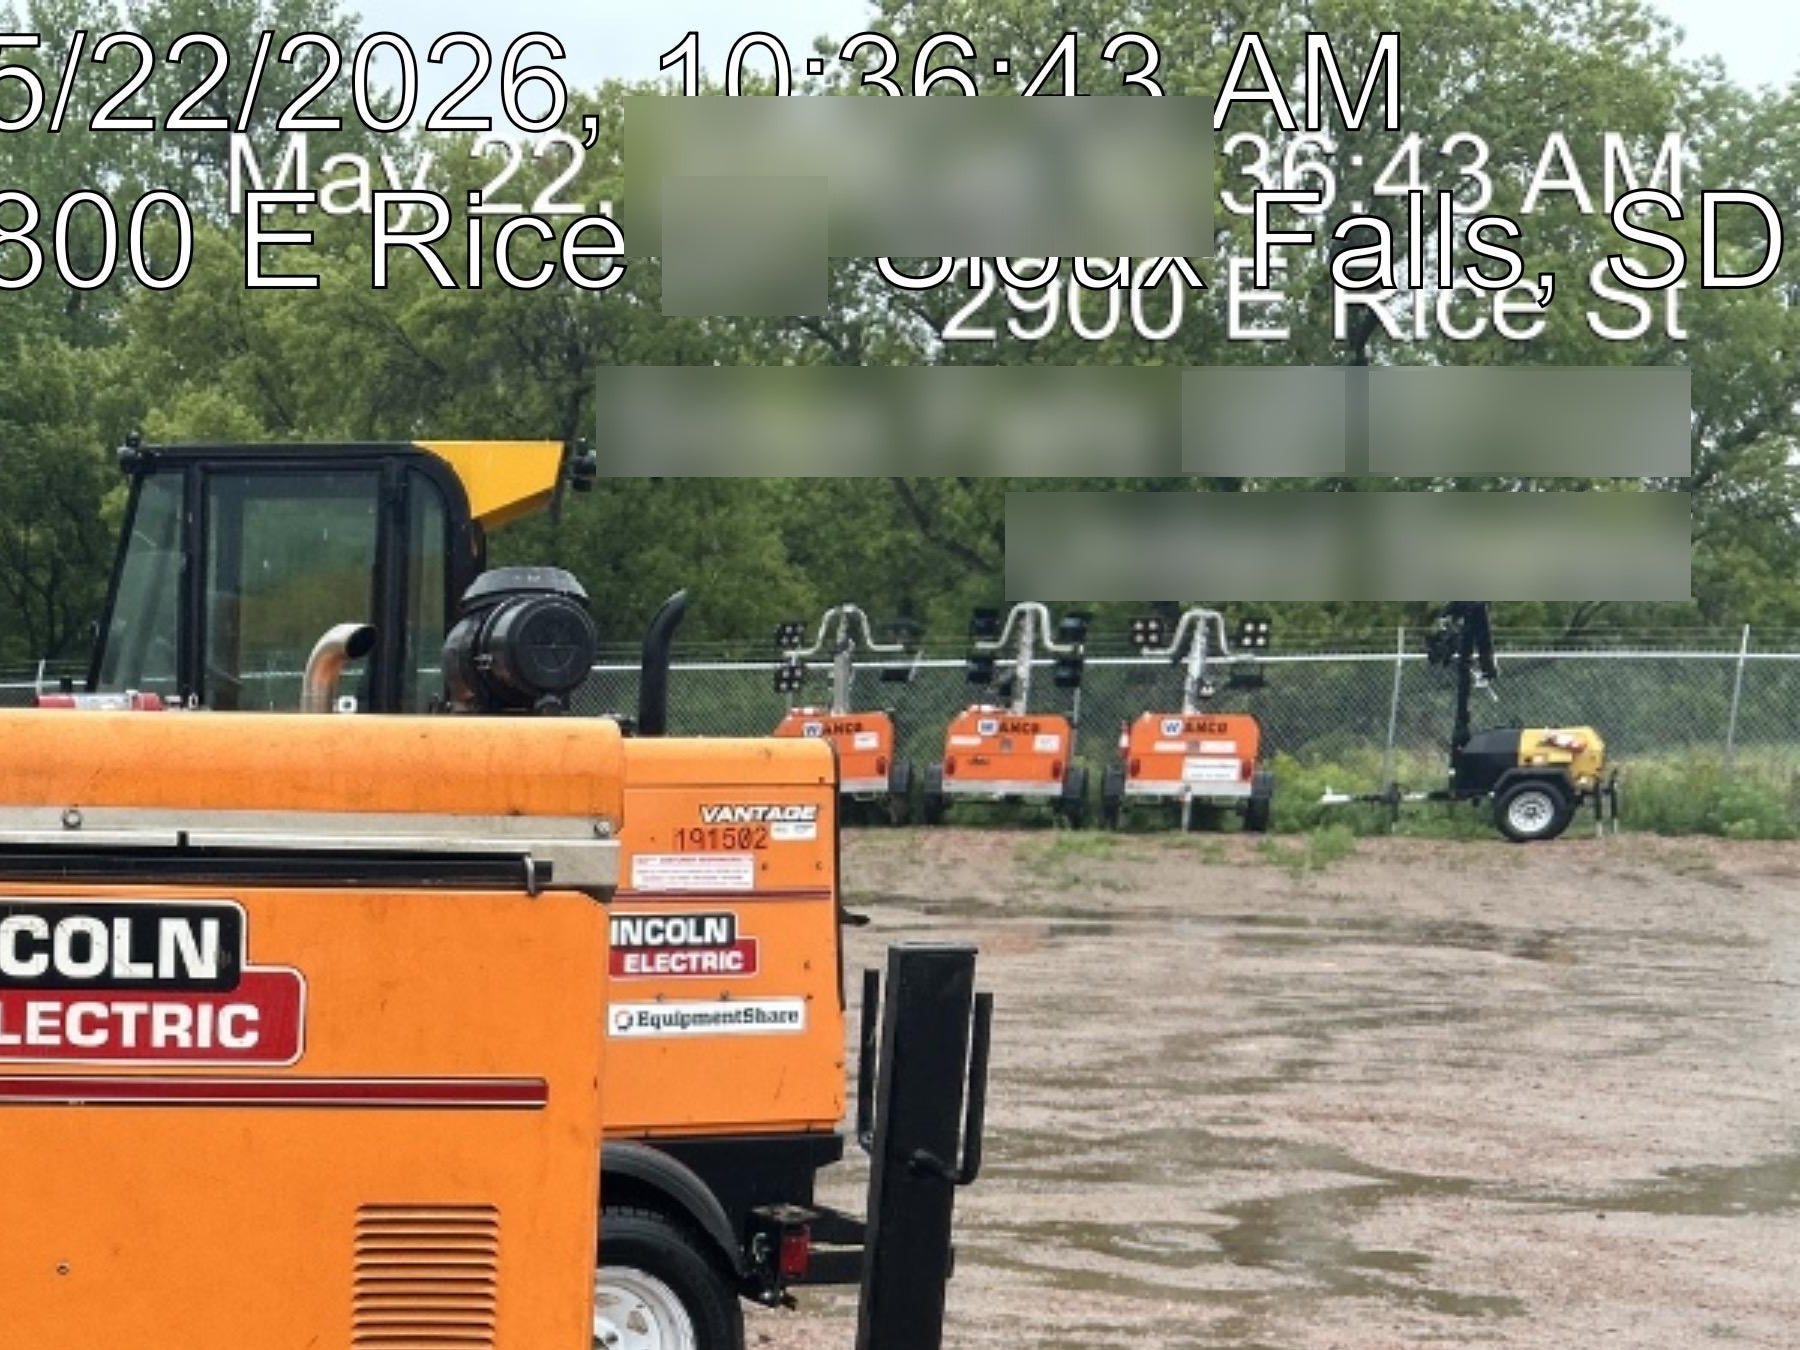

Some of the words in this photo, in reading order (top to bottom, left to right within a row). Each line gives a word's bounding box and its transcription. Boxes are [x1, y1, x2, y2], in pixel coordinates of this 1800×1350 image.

[701, 804, 817, 824] VANTAGE
[674, 826, 769, 852] 191502
[609, 917, 729, 947] INCOLN
[623, 951, 745, 974] ELECTRIC
[637, 1008, 799, 1031] EquipmentShare
